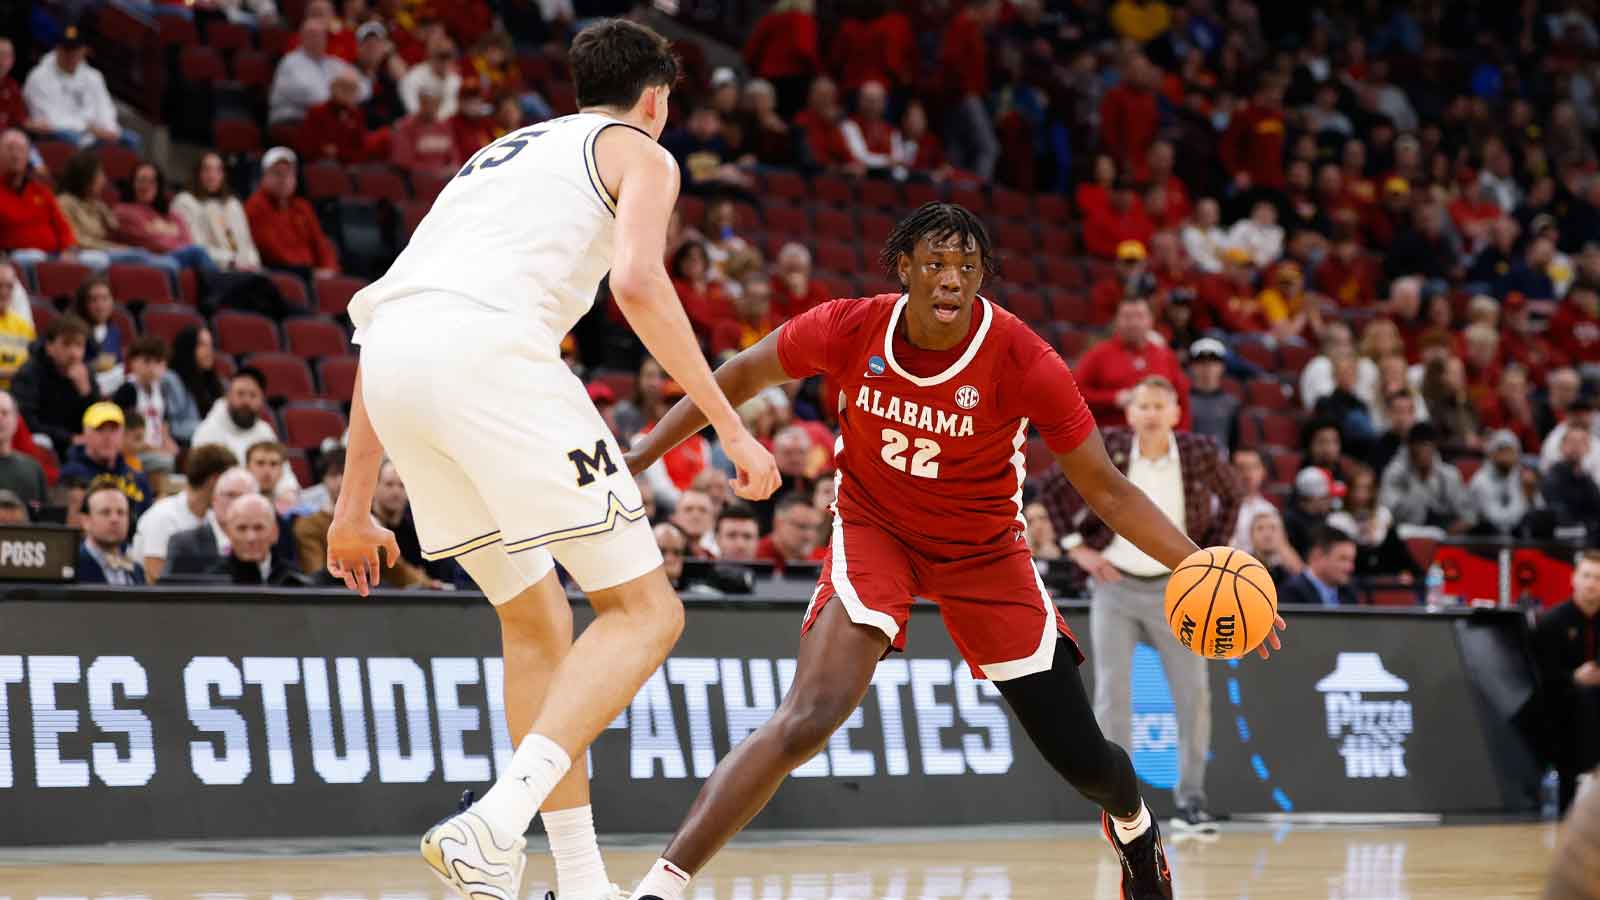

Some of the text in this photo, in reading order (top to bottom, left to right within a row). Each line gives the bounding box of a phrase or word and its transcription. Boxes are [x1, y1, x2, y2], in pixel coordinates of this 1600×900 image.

[856, 385, 974, 437] ALABAMA
[957, 387, 978, 407] SEC
[567, 439, 619, 487] M
[881, 428, 941, 479] 22
[0, 541, 46, 567] POSS
[1214, 615, 1235, 657] Wils
